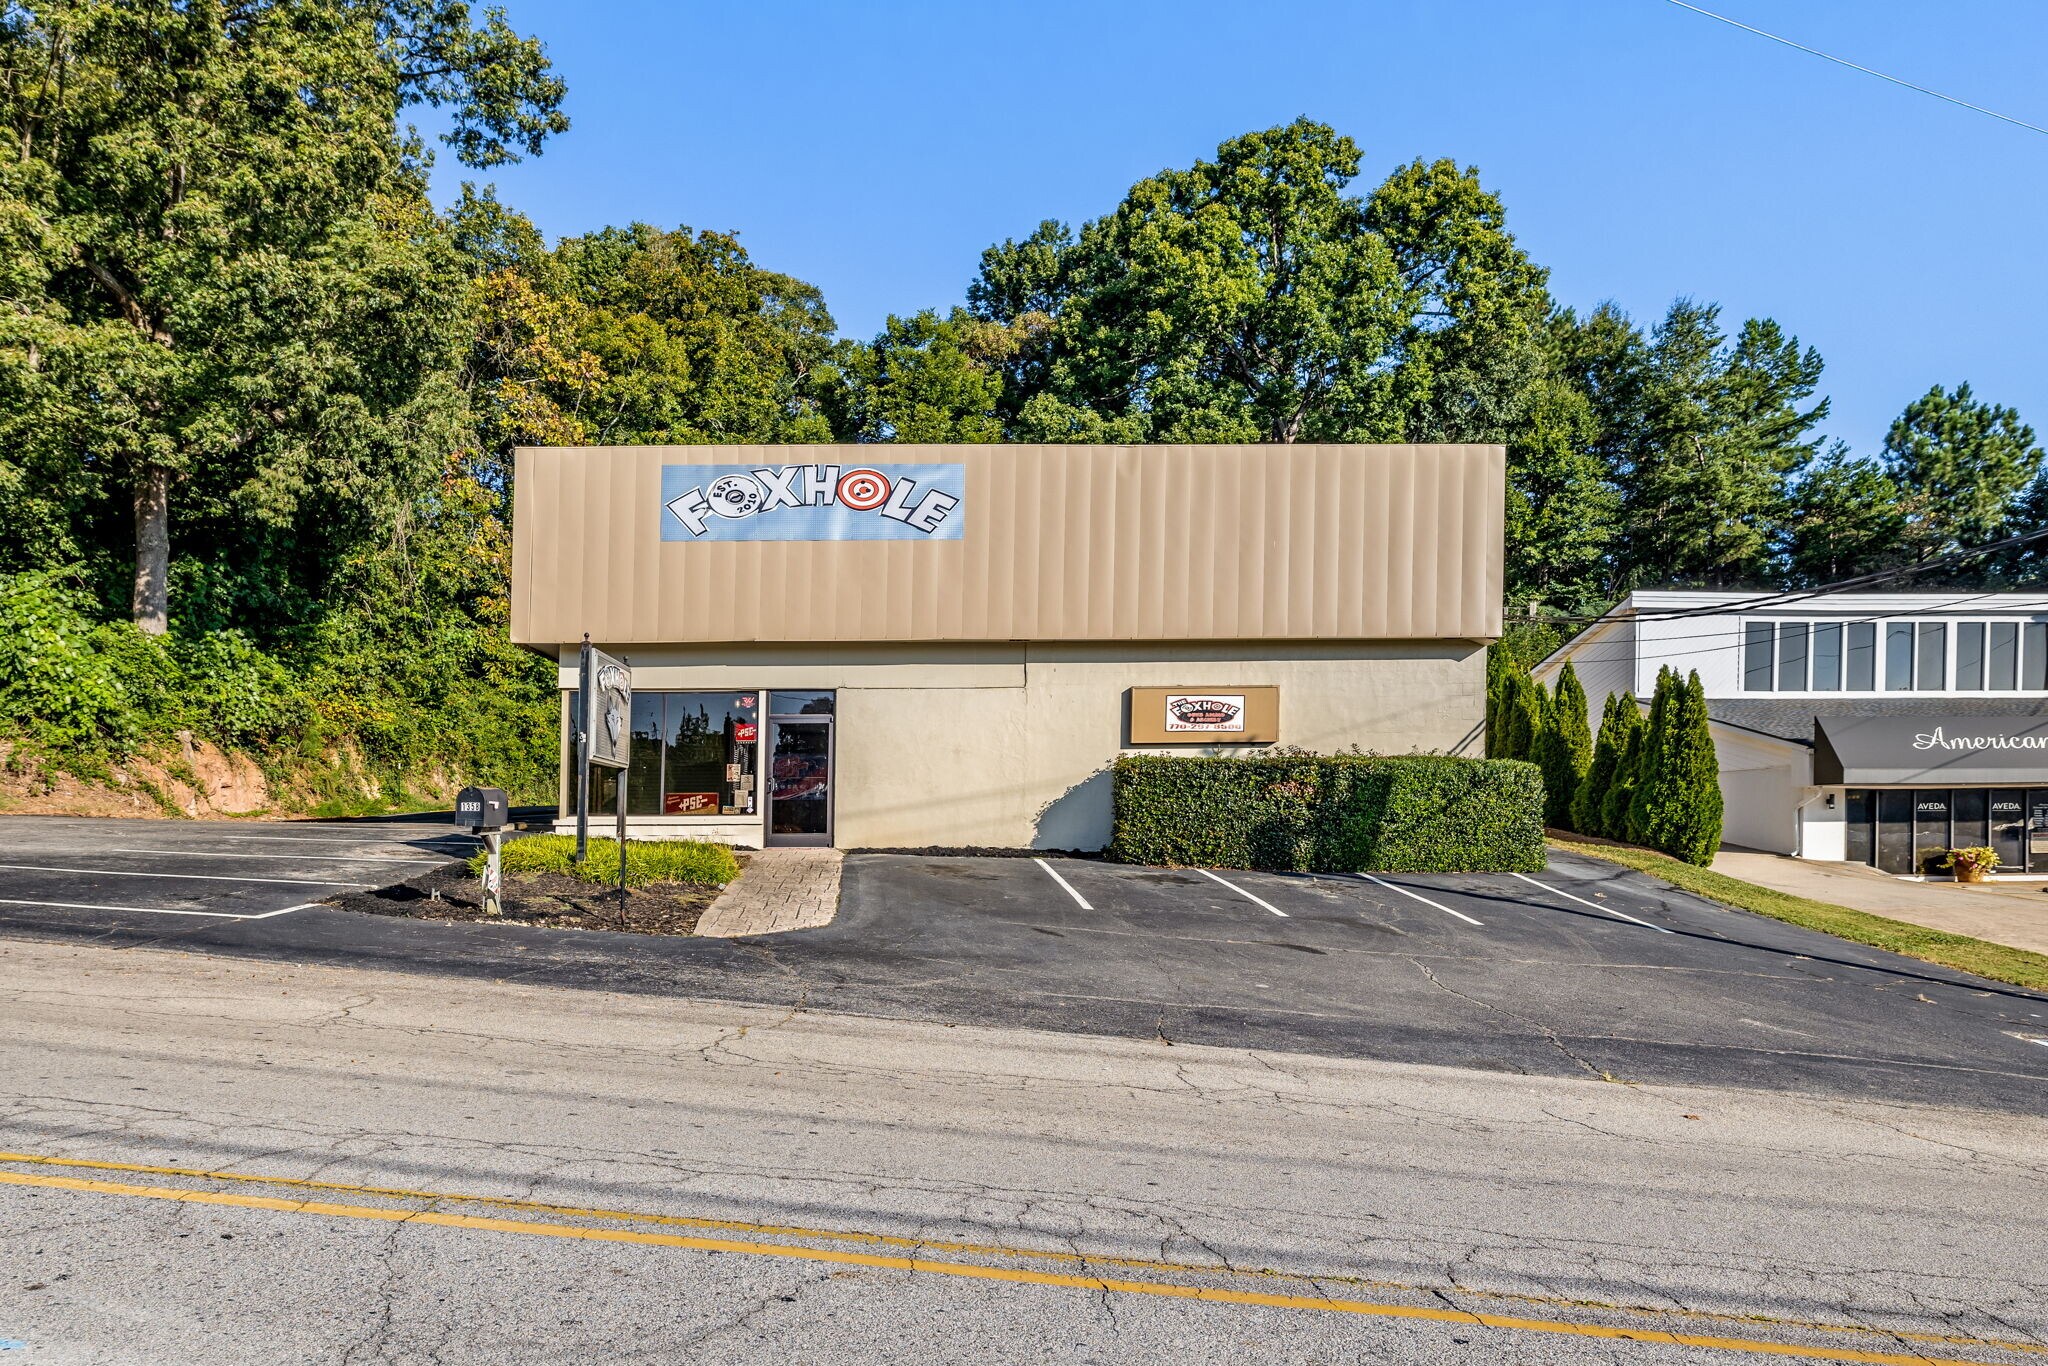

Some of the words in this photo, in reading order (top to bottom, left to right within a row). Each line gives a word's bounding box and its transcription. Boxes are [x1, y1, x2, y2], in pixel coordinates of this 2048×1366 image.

[664, 464, 960, 537] FOXHOLE
[713, 480, 738, 498] EST.
[736, 493, 757, 513] 2010
[1170, 700, 1241, 717] FOXHOLE
[739, 727, 754, 738] PSE
[462, 802, 480, 811] 1358
[682, 795, 703, 811] PSE
